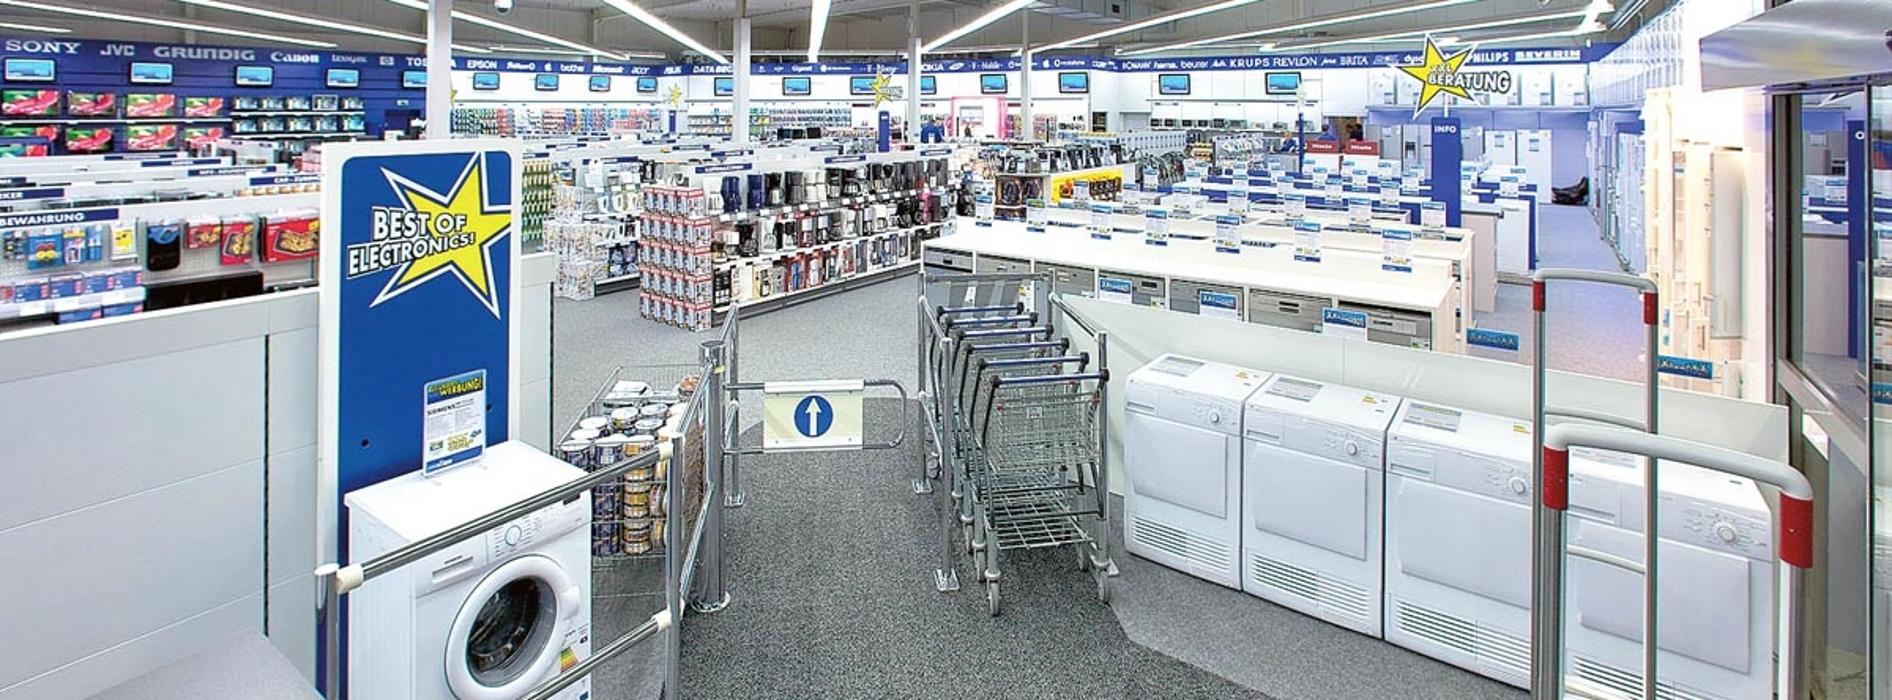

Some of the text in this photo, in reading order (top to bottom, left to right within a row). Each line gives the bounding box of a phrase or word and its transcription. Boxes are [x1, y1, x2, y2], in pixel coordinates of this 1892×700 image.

[5, 39, 81, 54] SONY
[100, 44, 135, 56] JVC
[153, 46, 256, 61] GRUNDIG
[270, 51, 319, 63] Canon
[1514, 50, 1581, 61] SEVERIN
[467, 59, 497, 69] EPSON
[1229, 58, 1270, 68] KRUPS
[1273, 56, 1318, 67] REVLON
[1340, 56, 1368, 65] BRITA
[693, 65, 714, 74] DATA
[920, 63, 944, 72] OKIA
[1428, 70, 1511, 94] BERATUNG
[1434, 125, 1457, 134] INFO
[373, 208, 467, 241] BEST OF
[348, 232, 476, 278] ELECTRONICS!
